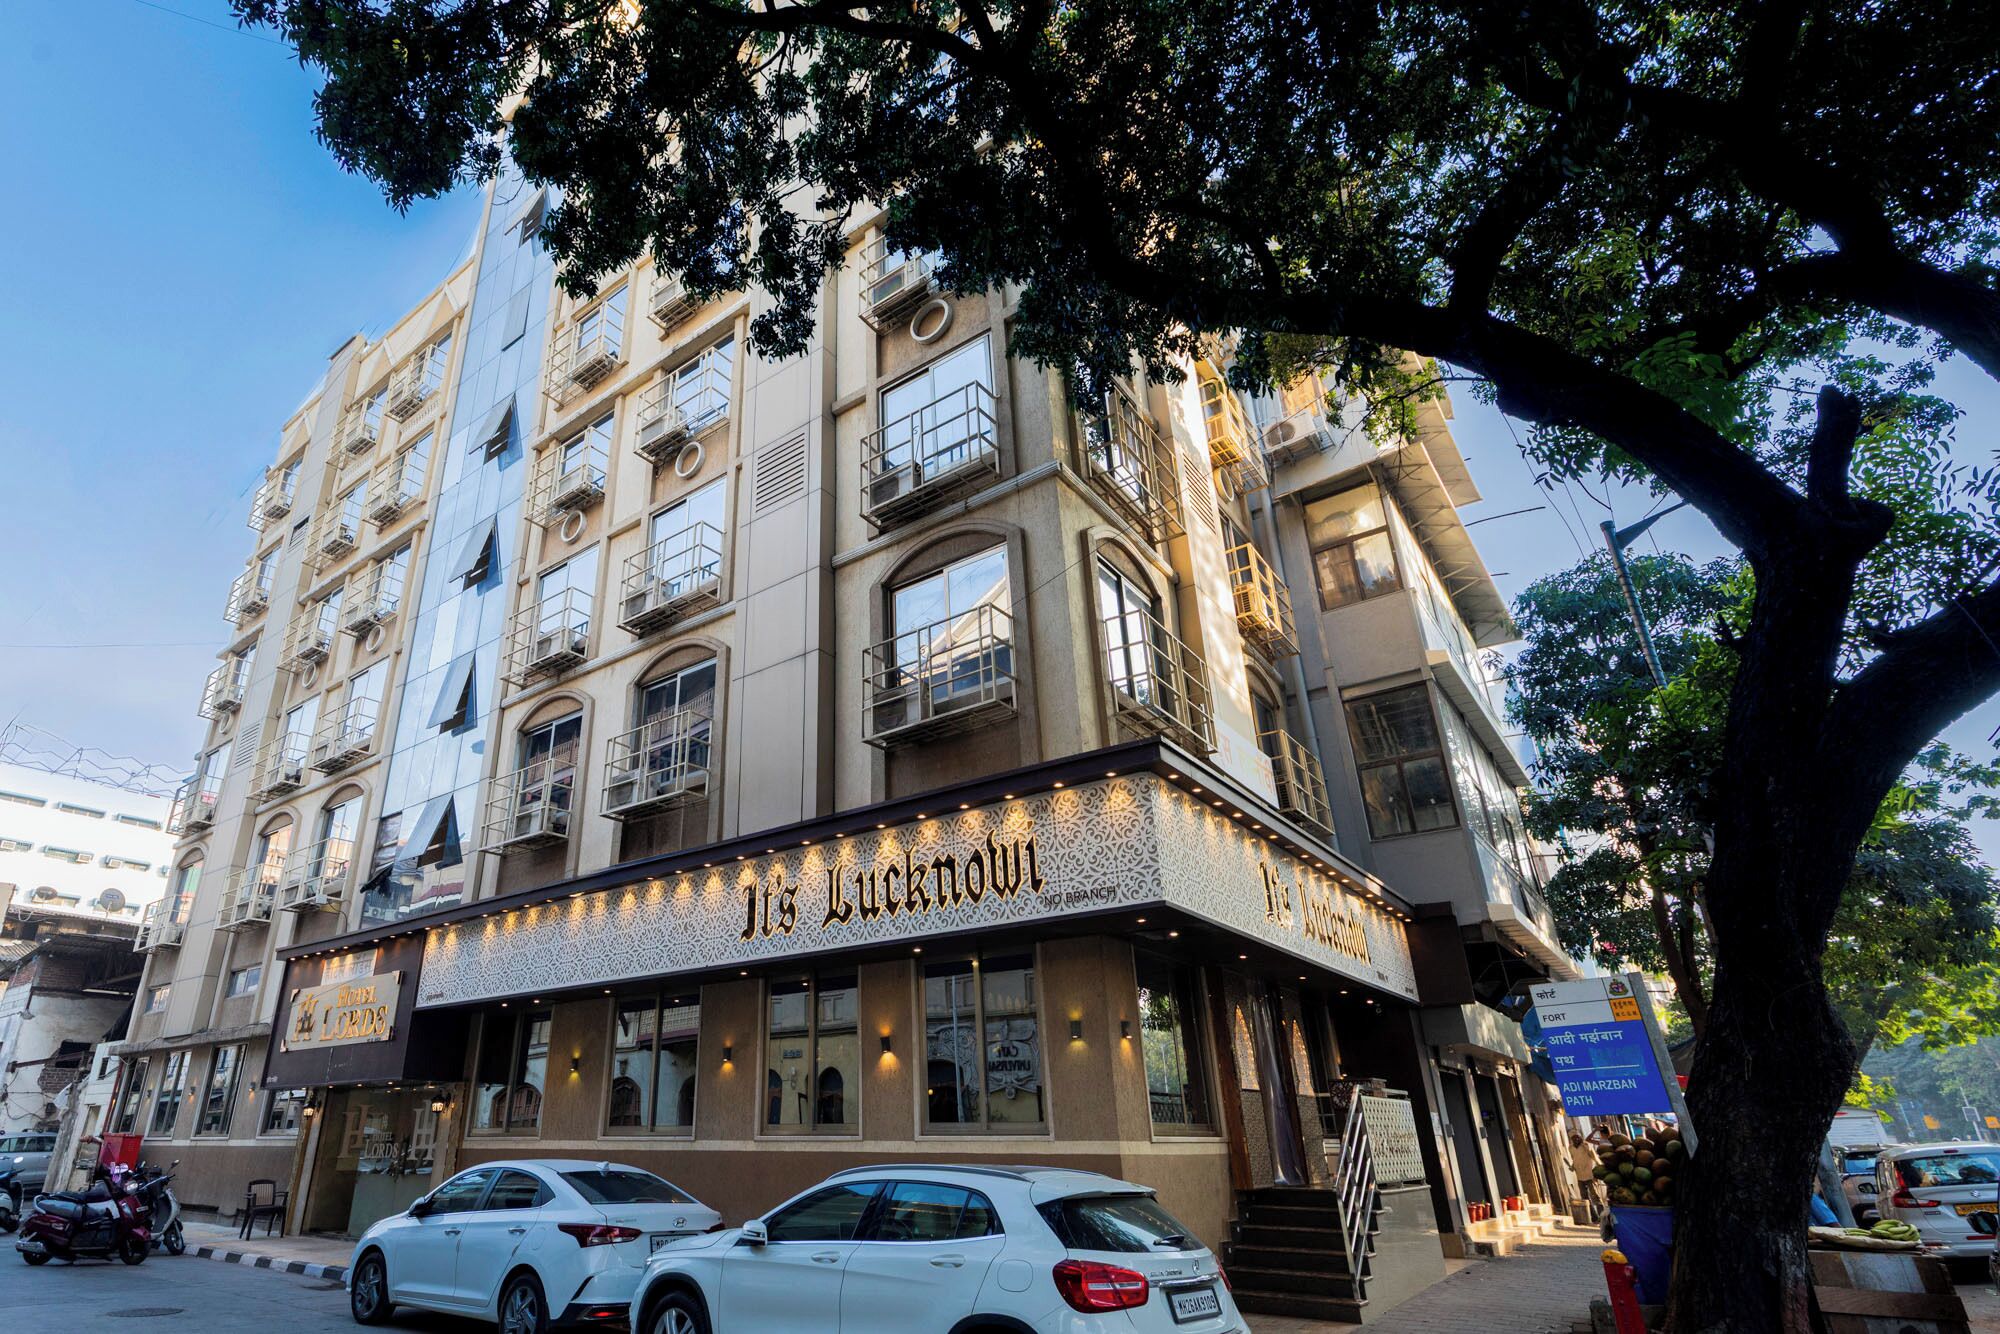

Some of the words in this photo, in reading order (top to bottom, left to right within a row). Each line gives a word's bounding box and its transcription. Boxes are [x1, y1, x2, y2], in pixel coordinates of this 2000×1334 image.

[740, 874, 801, 942] It's
[822, 820, 1045, 929] Lucknowi
[1044, 893, 1062, 906] NO
[1066, 885, 1117, 903] BRANCH
[336, 984, 378, 1008] HOTEL
[1536, 988, 1557, 1000] फोर्ट
[319, 1004, 389, 1042] LORDS
[1542, 1012, 1567, 1022] FORT
[1548, 1031, 1576, 1045] आदी
[1579, 1028, 1624, 1044] मर्झबान
[1554, 1055, 1575, 1067] पथ
[1563, 1081, 1581, 1093] ADI
[1584, 1078, 1637, 1091] MARZBAN
[1566, 1095, 1594, 1107] PATH
[364, 1139, 399, 1159] LORDS
